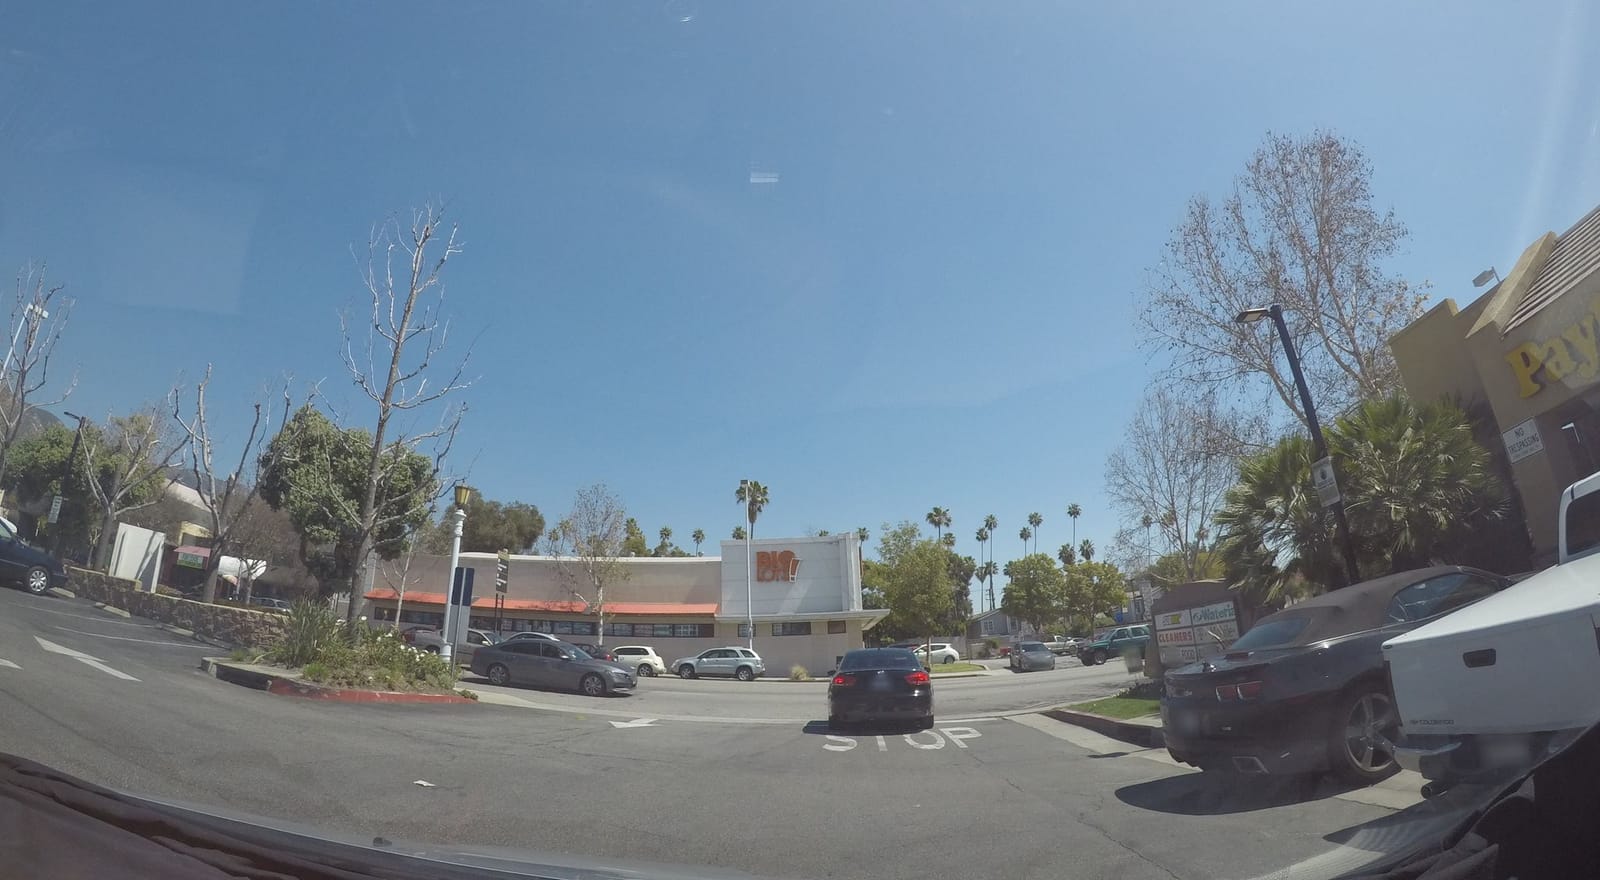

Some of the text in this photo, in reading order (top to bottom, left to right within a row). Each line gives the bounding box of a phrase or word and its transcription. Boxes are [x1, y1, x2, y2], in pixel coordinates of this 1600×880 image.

[1513, 426, 1525, 438] NO
[1508, 432, 1540, 453] TRESPASSING
[1159, 631, 1193, 643] CLEANERS
